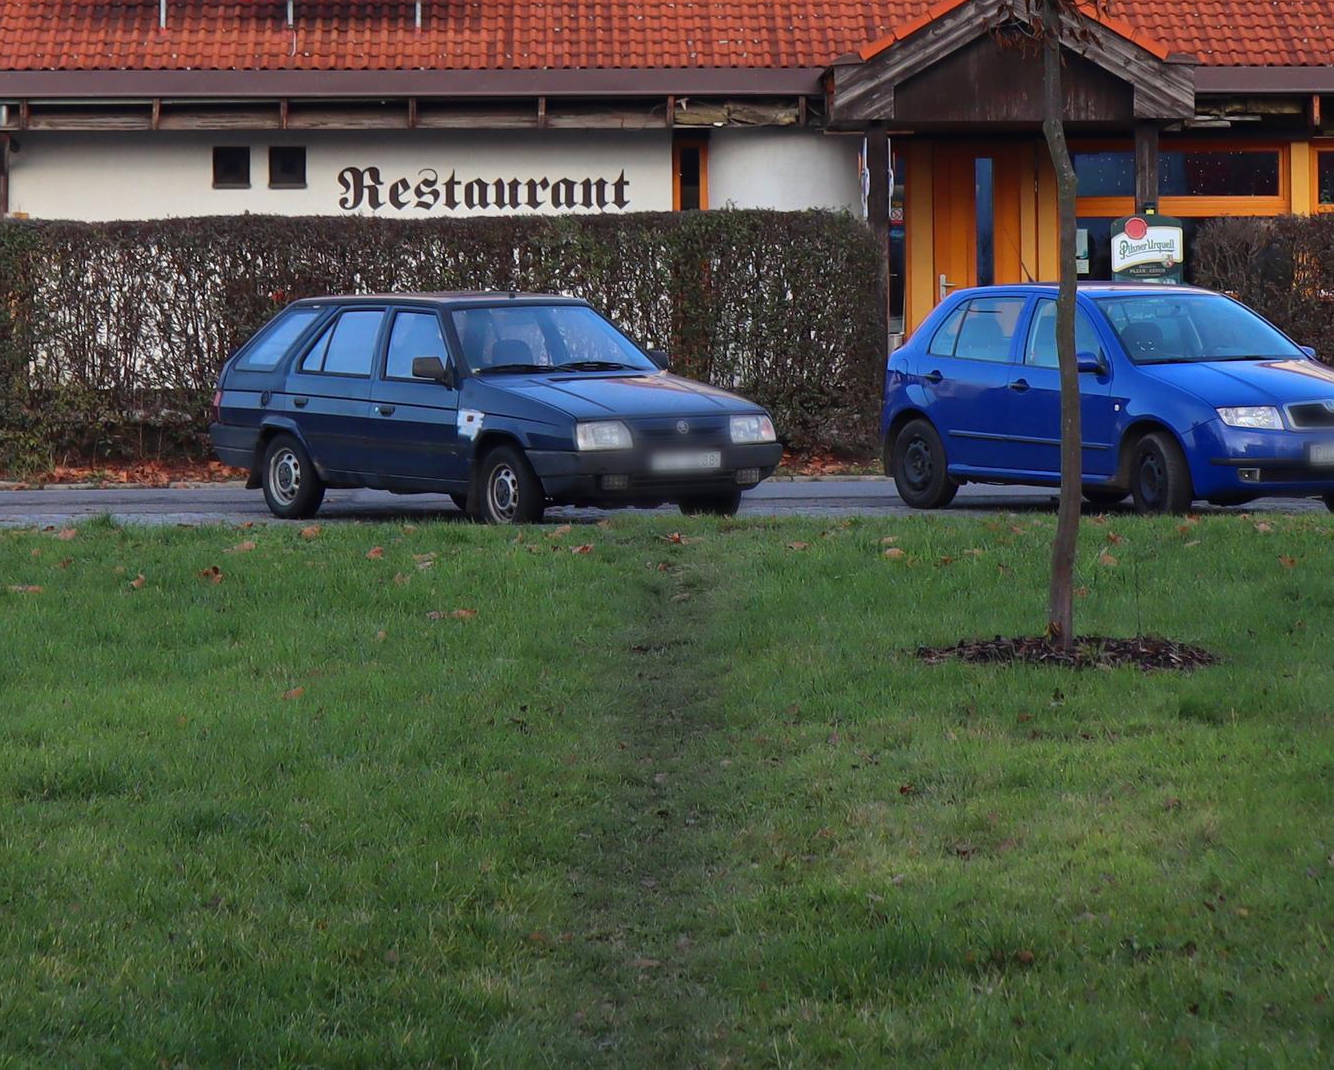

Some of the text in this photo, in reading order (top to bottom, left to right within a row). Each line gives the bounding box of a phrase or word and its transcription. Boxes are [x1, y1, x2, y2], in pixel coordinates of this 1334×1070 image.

[337, 166, 631, 211] Restaurant
[1119, 238, 1175, 260] Pilsner Urquell
